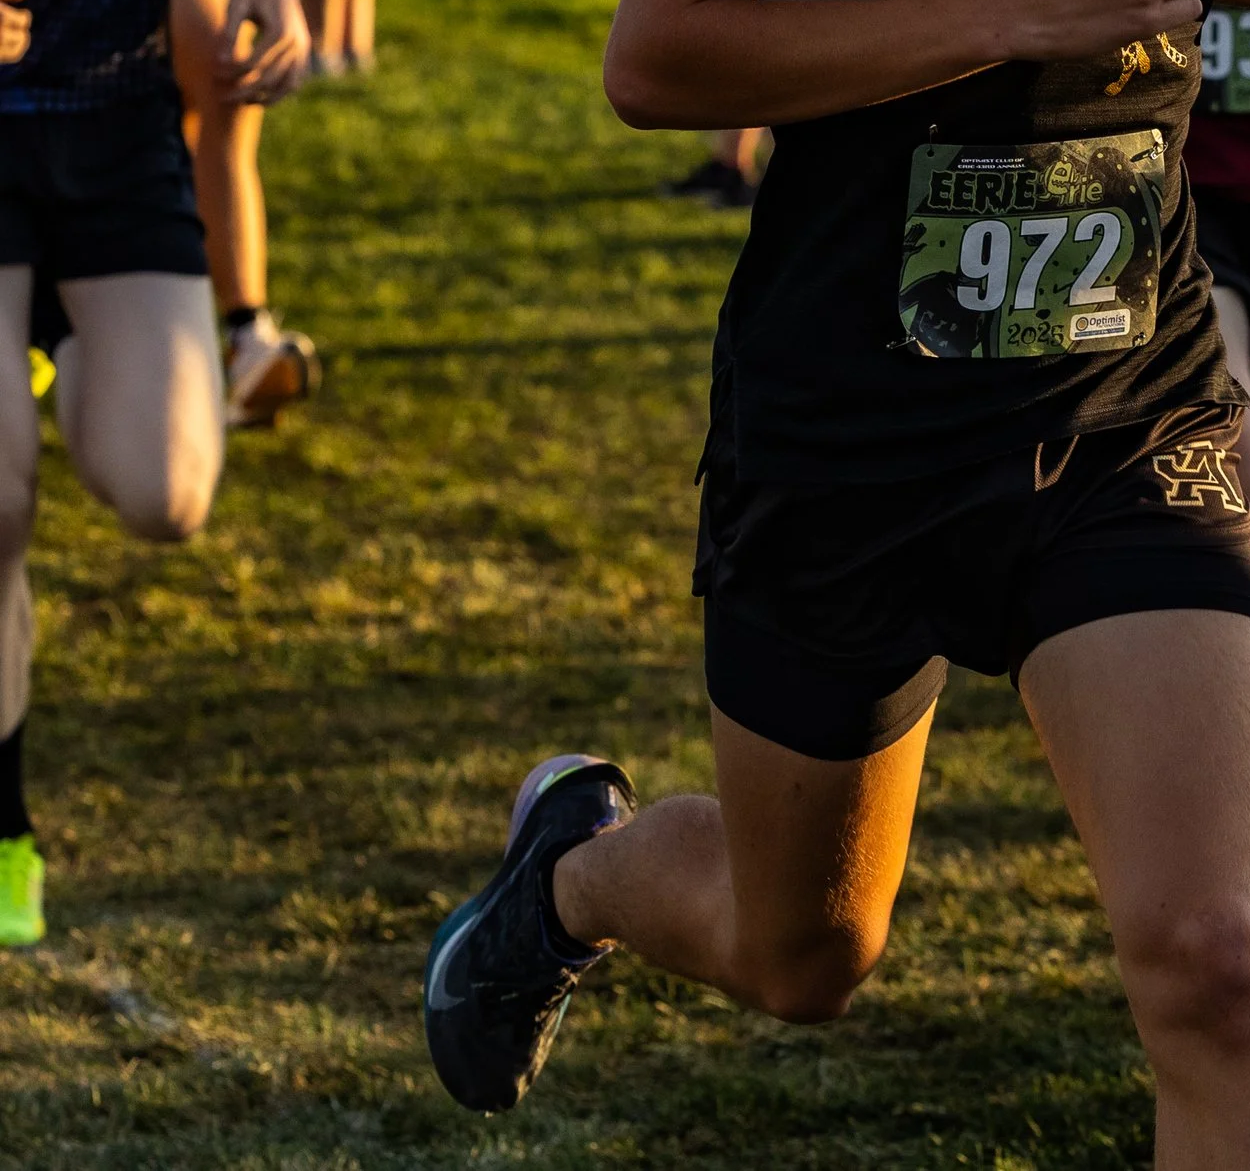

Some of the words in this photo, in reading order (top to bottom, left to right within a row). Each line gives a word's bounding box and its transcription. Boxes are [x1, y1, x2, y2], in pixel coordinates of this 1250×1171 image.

[928, 170, 1038, 213] EERIE
[957, 212, 1122, 312] 972
[1007, 320, 1065, 347] 2025
[1089, 314, 1126, 327] Optimist
